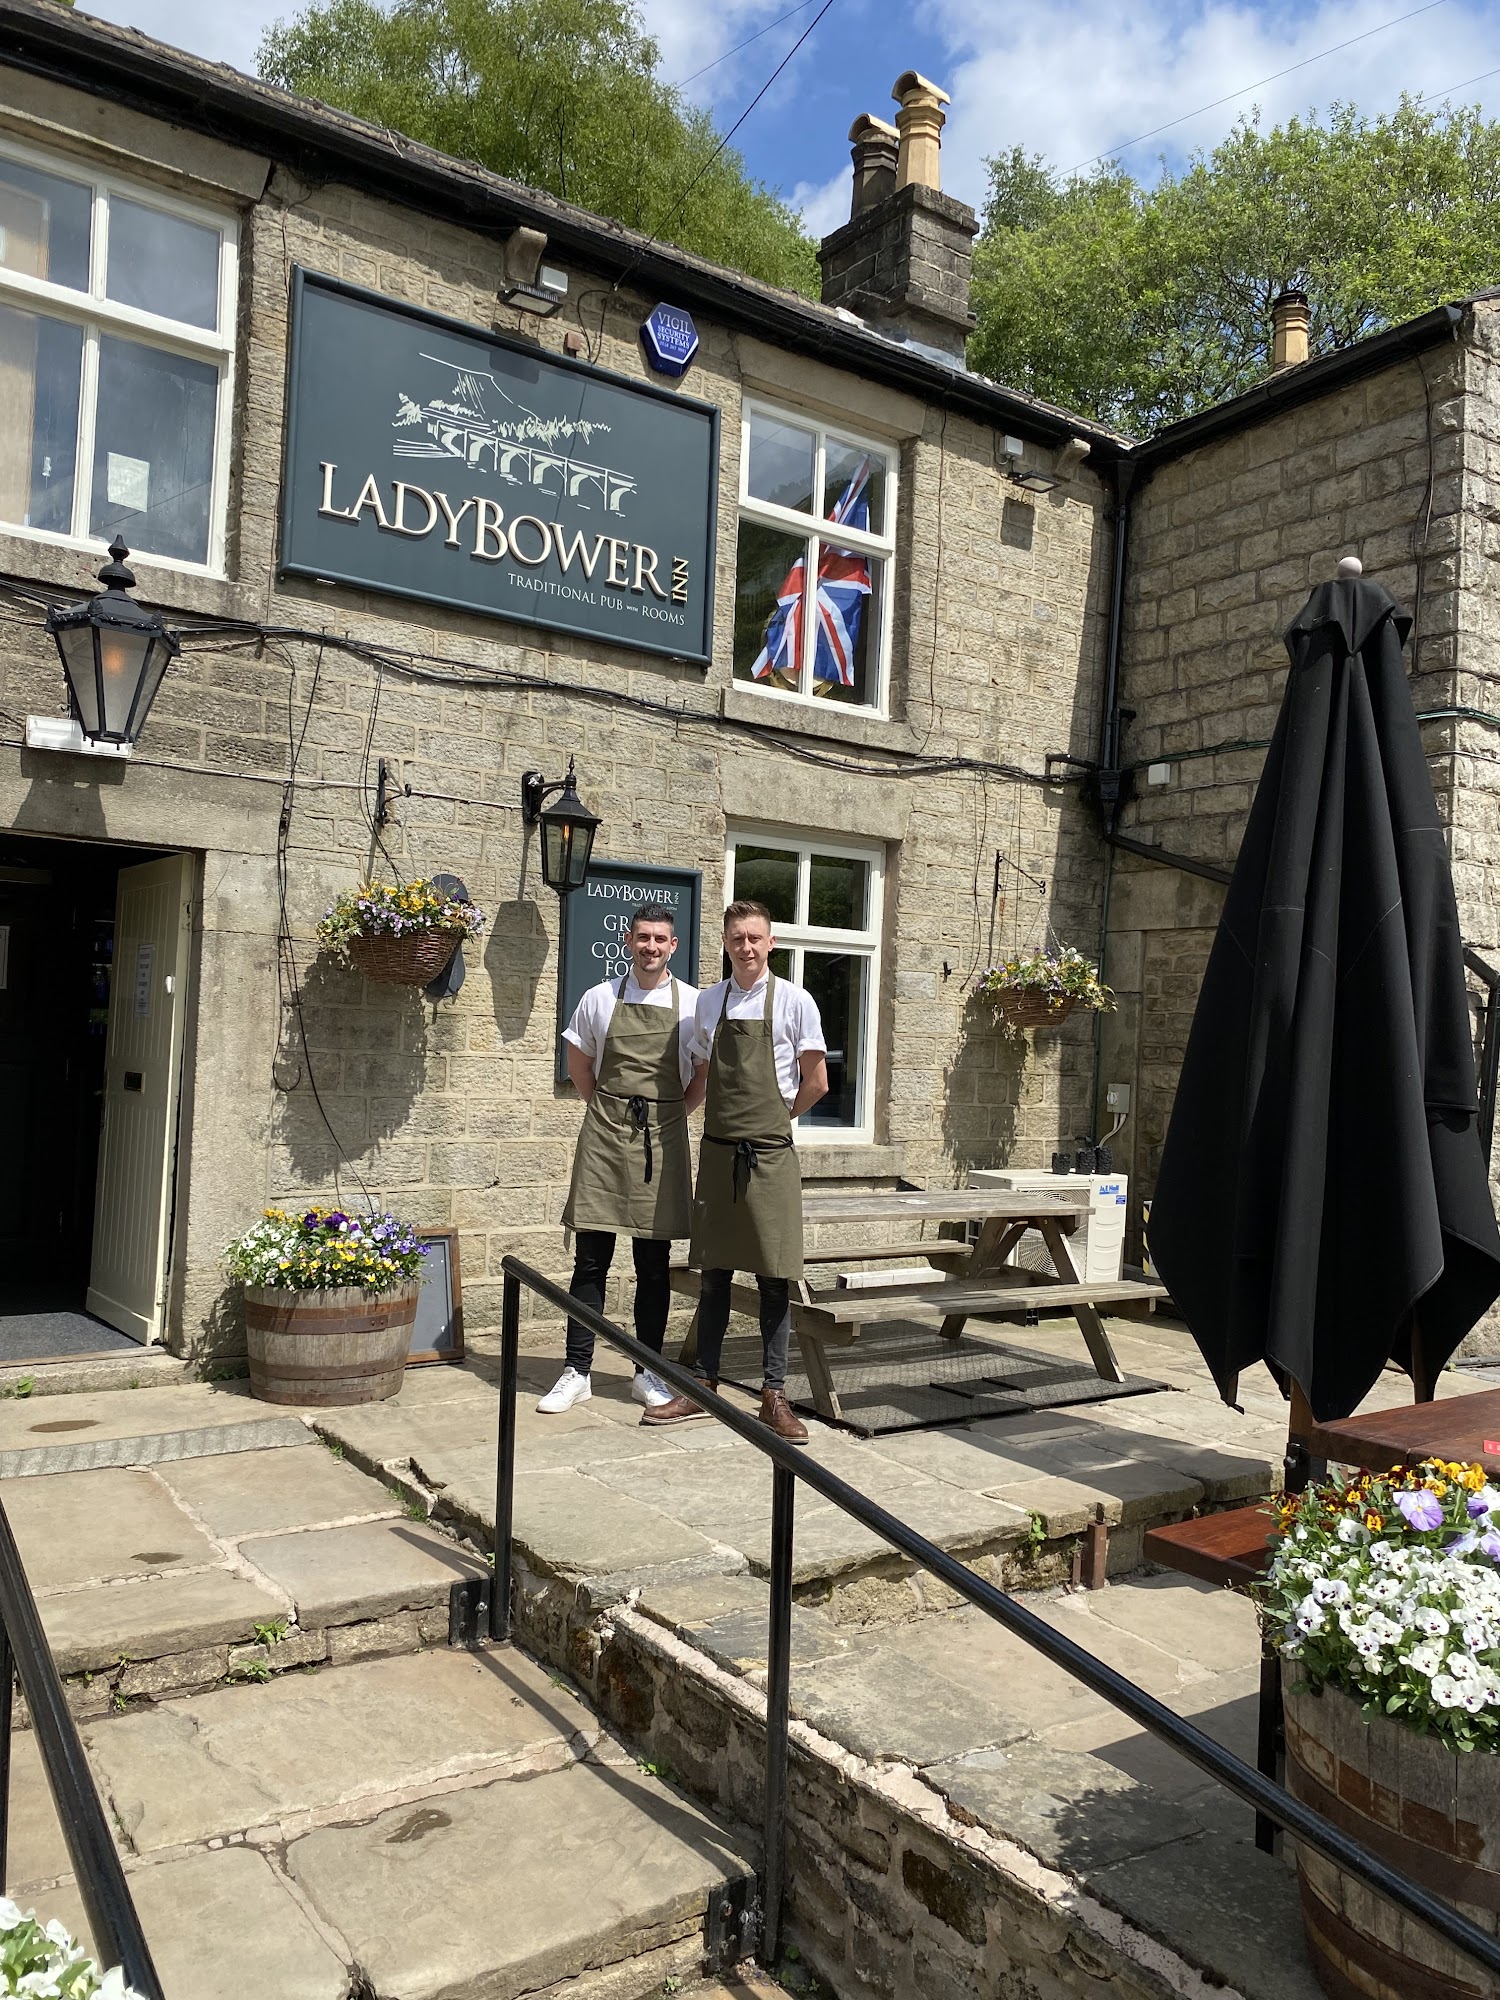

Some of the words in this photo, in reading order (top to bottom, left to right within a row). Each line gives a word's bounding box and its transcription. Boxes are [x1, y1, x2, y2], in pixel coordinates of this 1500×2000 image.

[658, 312, 691, 334] VIGIL
[658, 325, 690, 341] SECURITY
[657, 332, 690, 349] SYSTEMS
[671, 556, 690, 603] INN
[508, 573, 596, 604] TRADITIONAL
[600, 595, 623, 611] PUB
[642, 605, 685, 626] ROOMS
